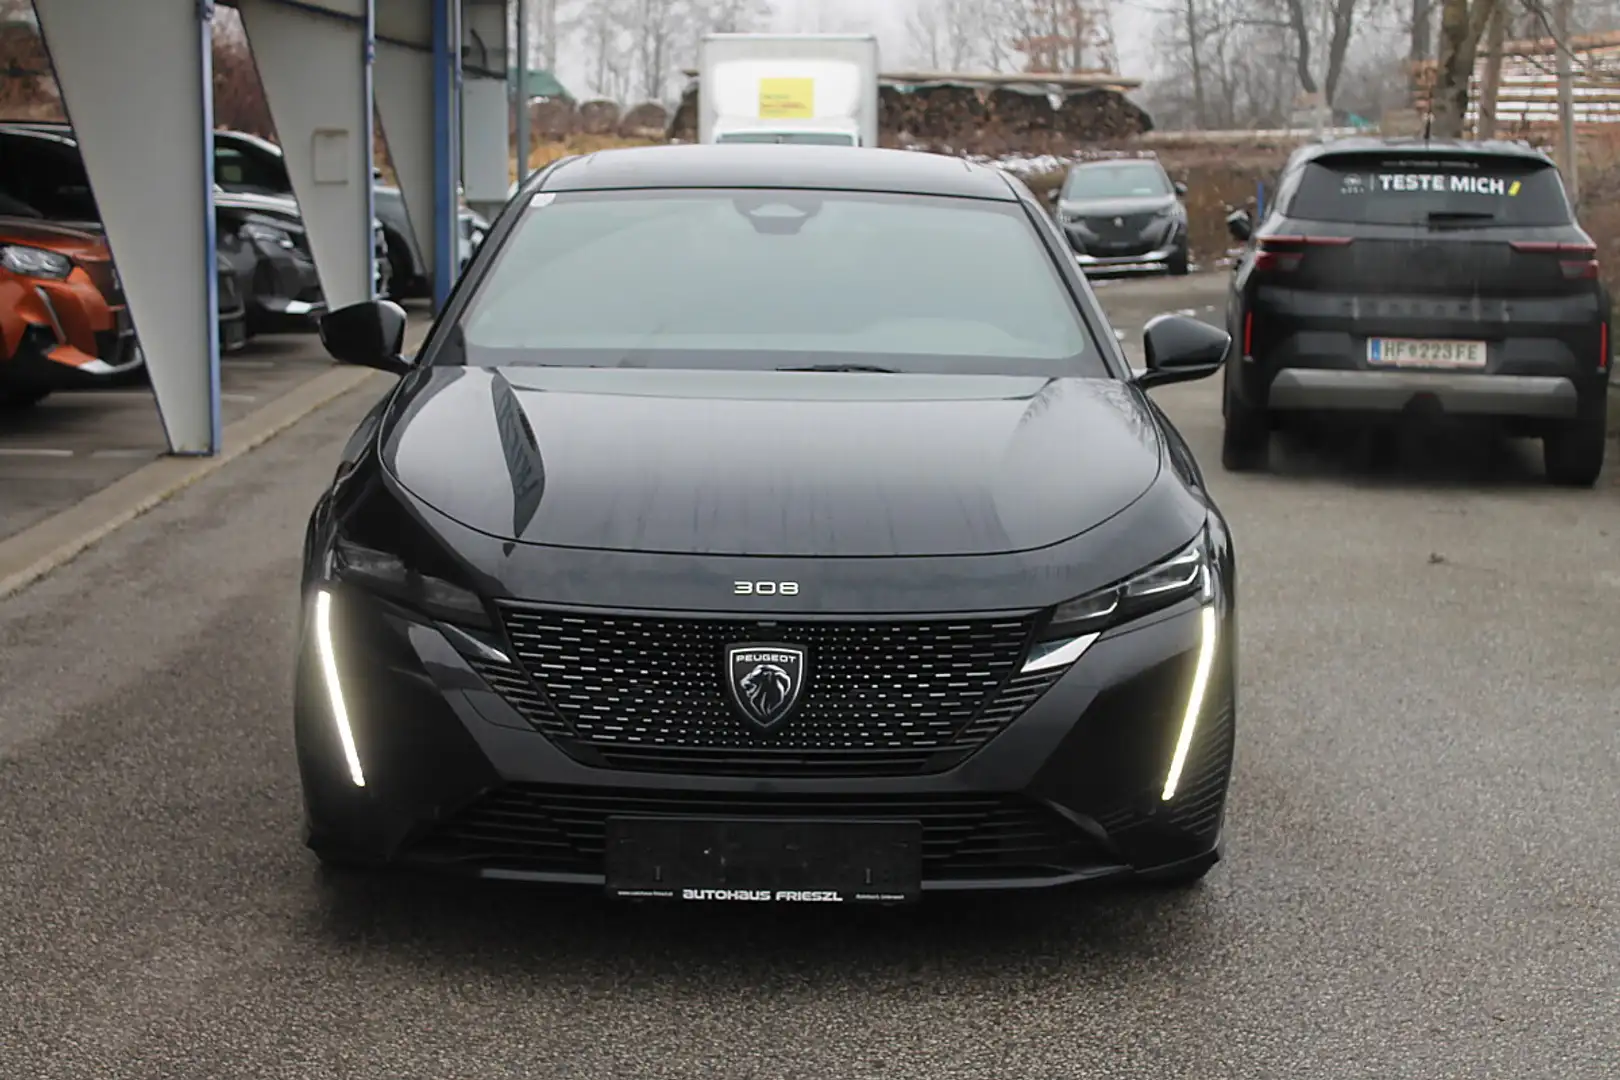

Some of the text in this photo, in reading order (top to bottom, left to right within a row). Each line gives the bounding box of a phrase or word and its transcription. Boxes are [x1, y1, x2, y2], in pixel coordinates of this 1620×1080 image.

[1379, 174, 1504, 196] TESTE MICH
[734, 581, 799, 595] 308
[736, 653, 797, 664] PEUGEOT
[775, 890, 843, 903] FRIESZL
